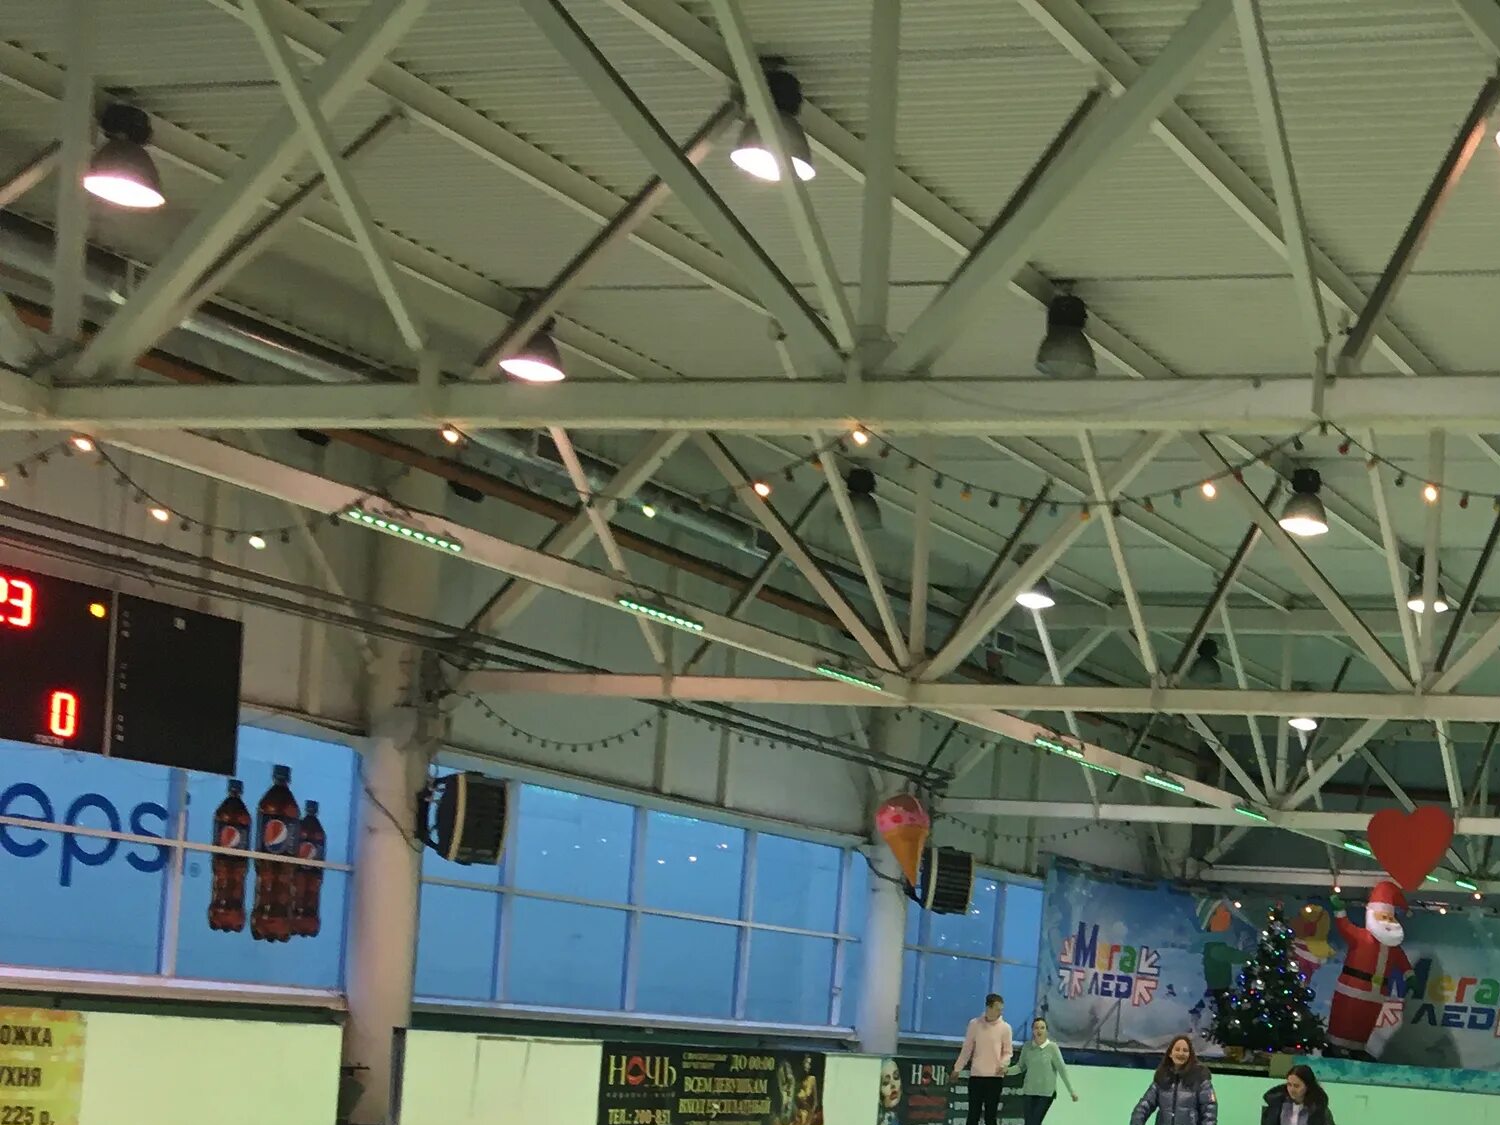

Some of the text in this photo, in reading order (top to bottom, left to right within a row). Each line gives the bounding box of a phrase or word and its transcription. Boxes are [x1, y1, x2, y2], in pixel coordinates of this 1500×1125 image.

[50, 690, 76, 737] 0
[0, 782, 191, 887] eps
[1, 1105, 35, 1125] 225
